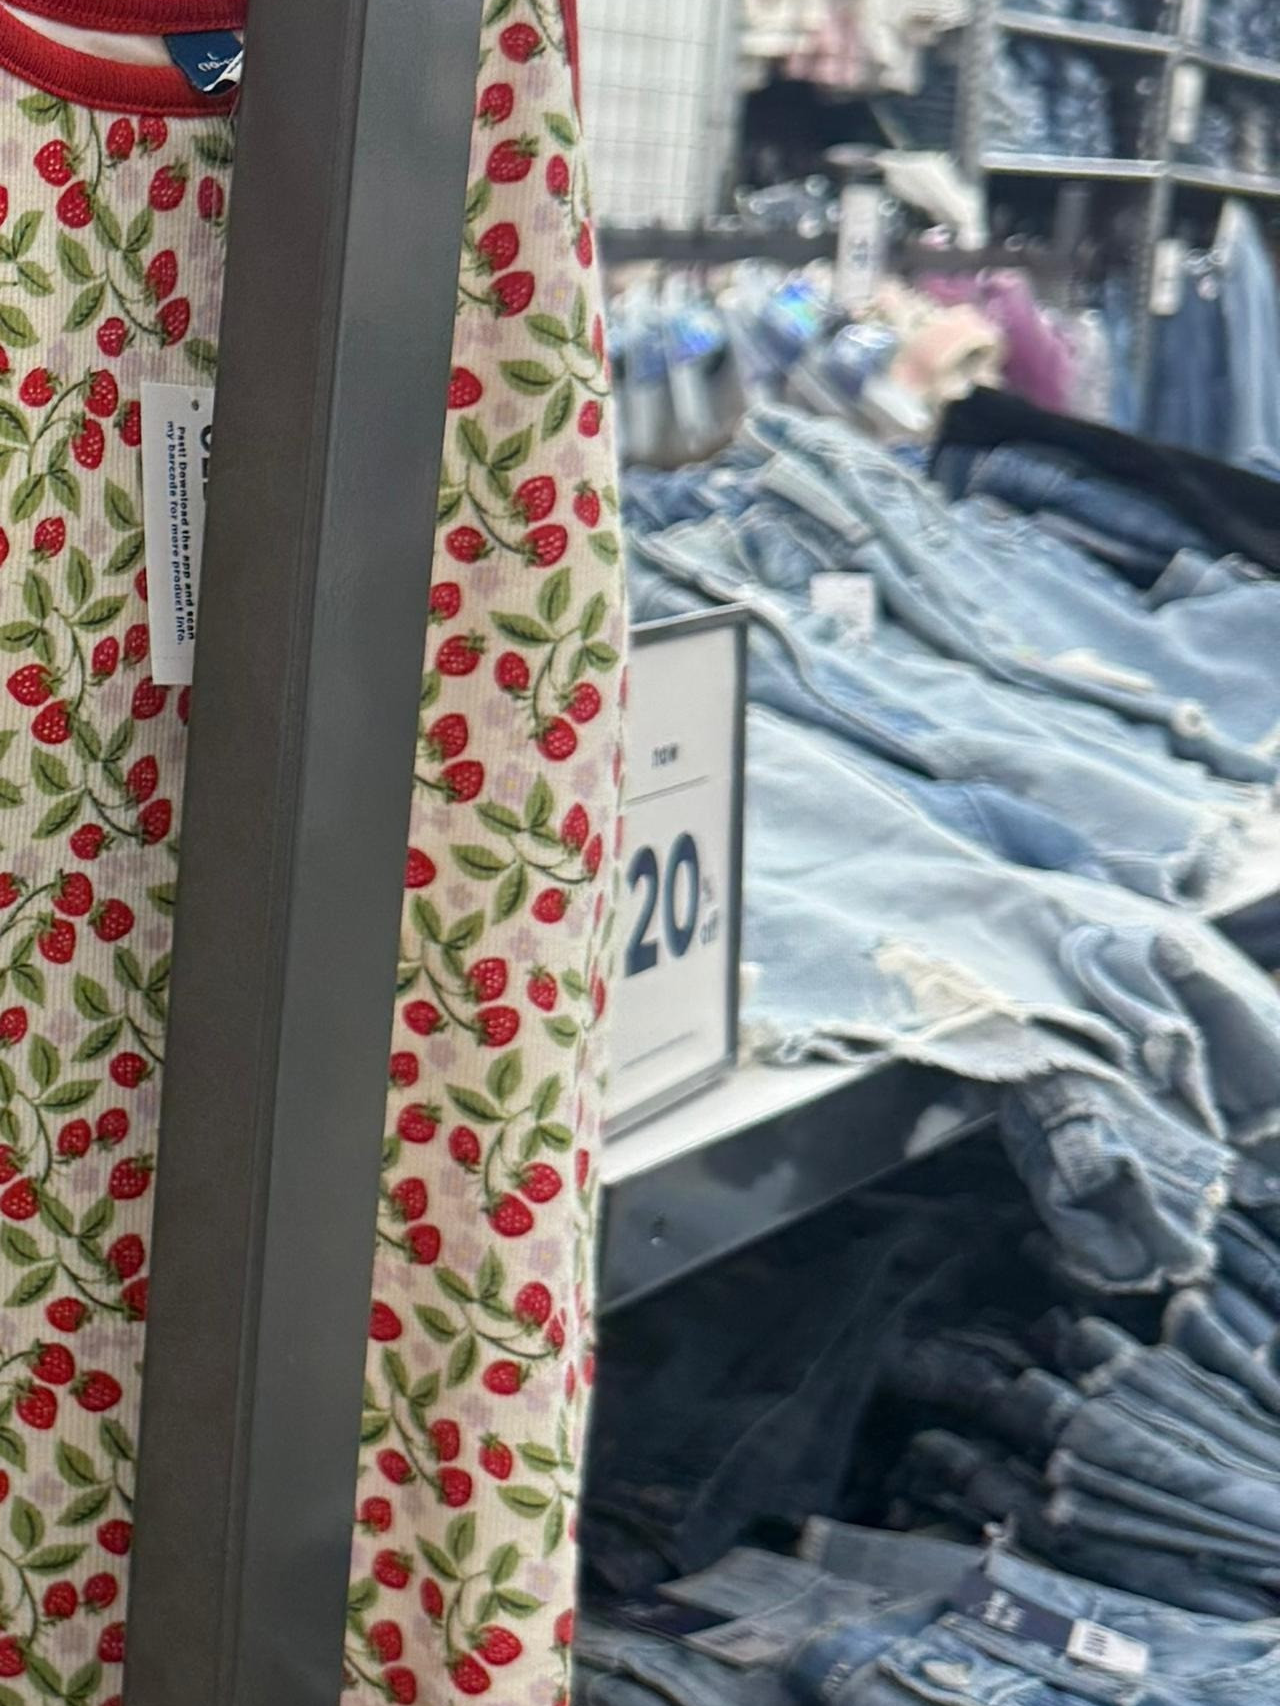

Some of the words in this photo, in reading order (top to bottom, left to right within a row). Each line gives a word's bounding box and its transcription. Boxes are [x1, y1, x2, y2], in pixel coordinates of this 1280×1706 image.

[166, 421, 174, 440] my
[168, 444, 178, 497] barcode
[179, 461, 189, 526] Download
[170, 500, 178, 520] for
[171, 523, 179, 557] more
[181, 530, 191, 551] the
[182, 555, 191, 579] app
[171, 561, 183, 612] product
[185, 583, 194, 606] and
[186, 611, 195, 640] scan
